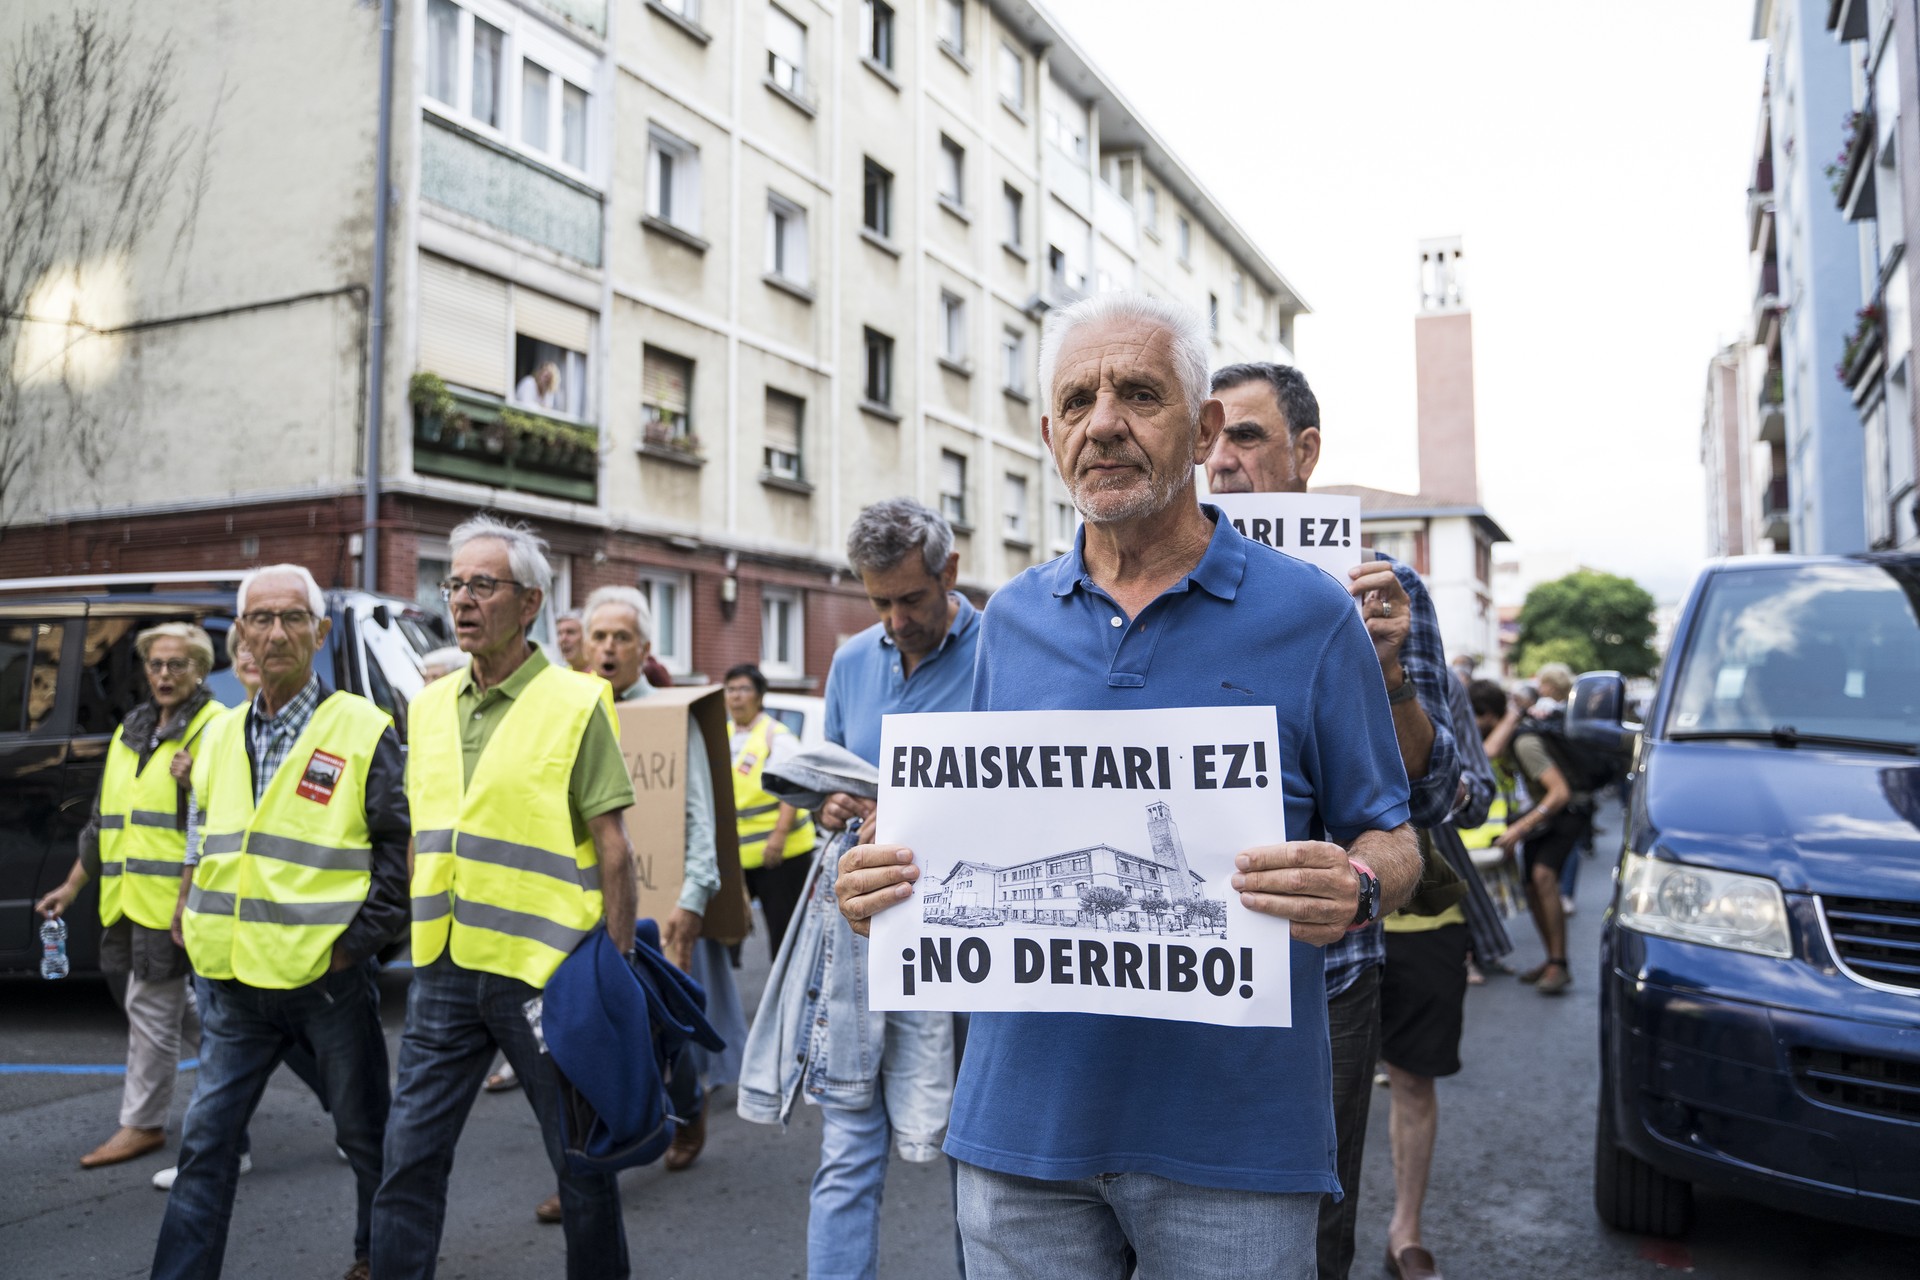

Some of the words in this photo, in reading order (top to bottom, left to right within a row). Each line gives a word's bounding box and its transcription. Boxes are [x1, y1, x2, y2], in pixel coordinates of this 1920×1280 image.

[1300, 518, 1351, 547] EZ!
[891, 746, 1171, 790] ERAISKETARI
[1192, 741, 1269, 790] EZ!
[902, 937, 991, 996] ¡NO
[1013, 938, 1254, 999] DERRIBO!
